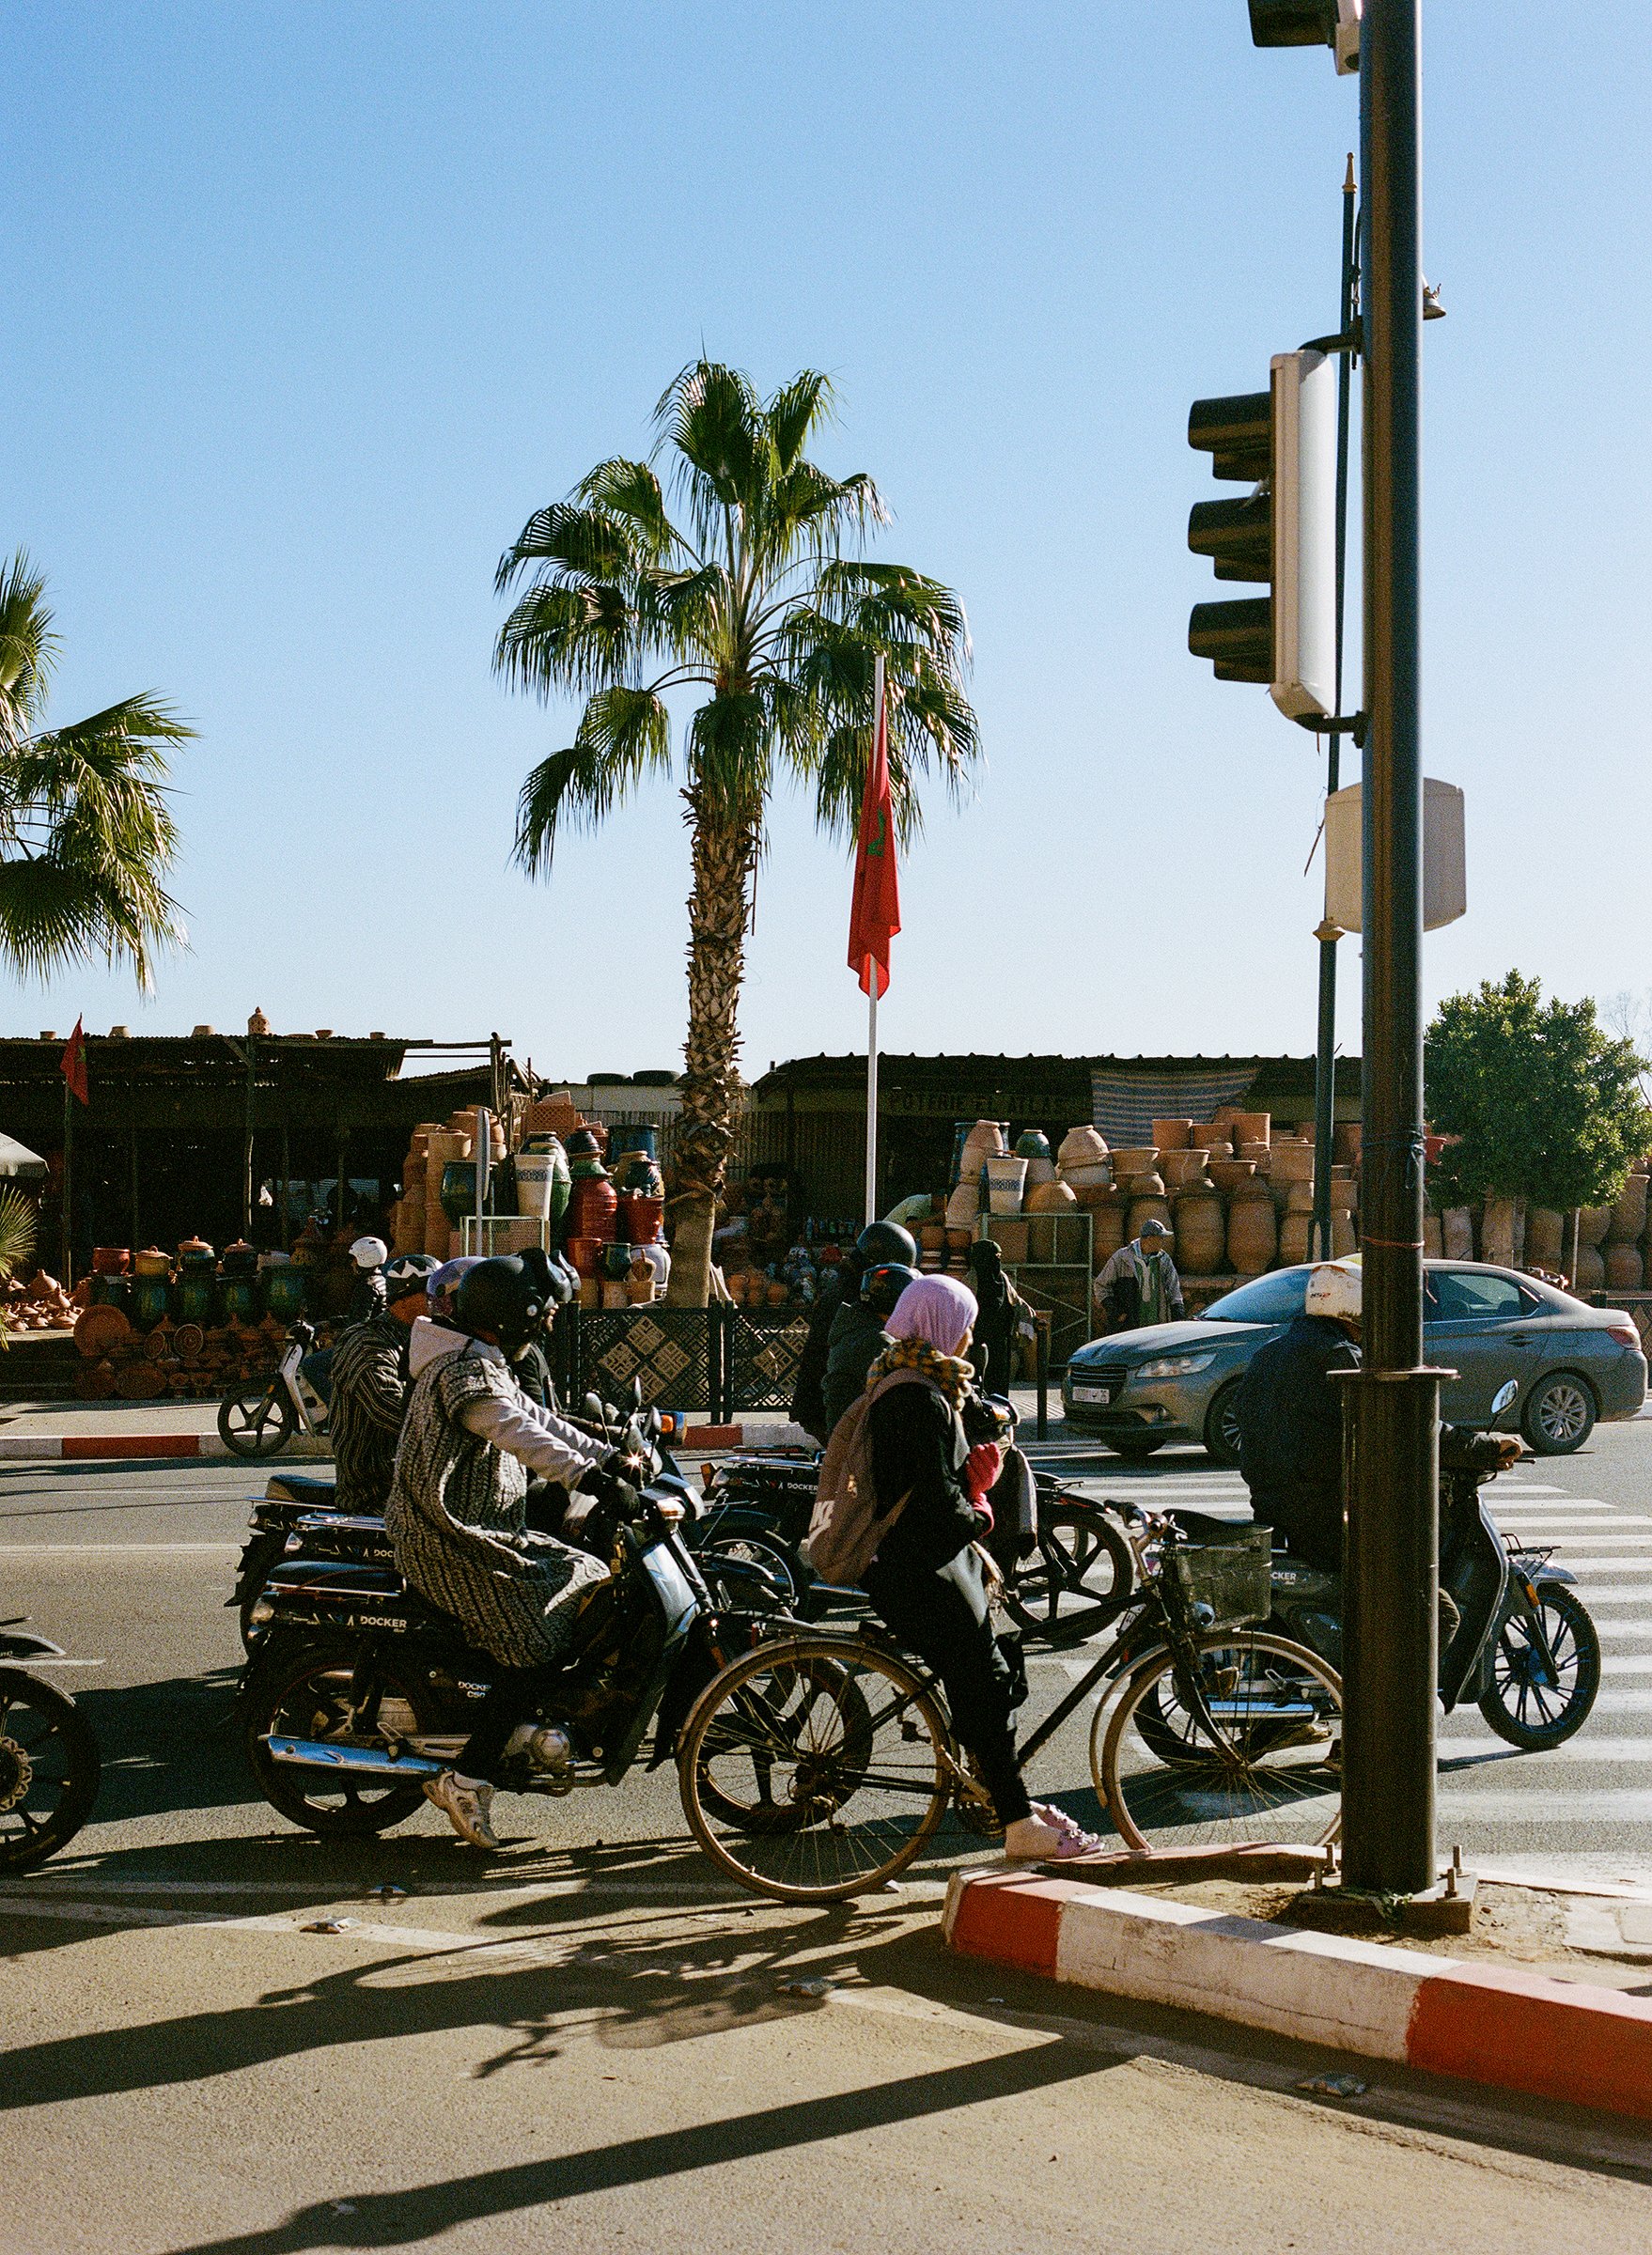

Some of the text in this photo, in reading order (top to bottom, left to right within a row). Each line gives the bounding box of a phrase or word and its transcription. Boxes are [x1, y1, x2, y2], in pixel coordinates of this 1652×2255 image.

[373, 1548, 394, 1559] DOC
[1270, 1571, 1297, 1580] CKER
[360, 1615, 407, 1628] DOCKER
